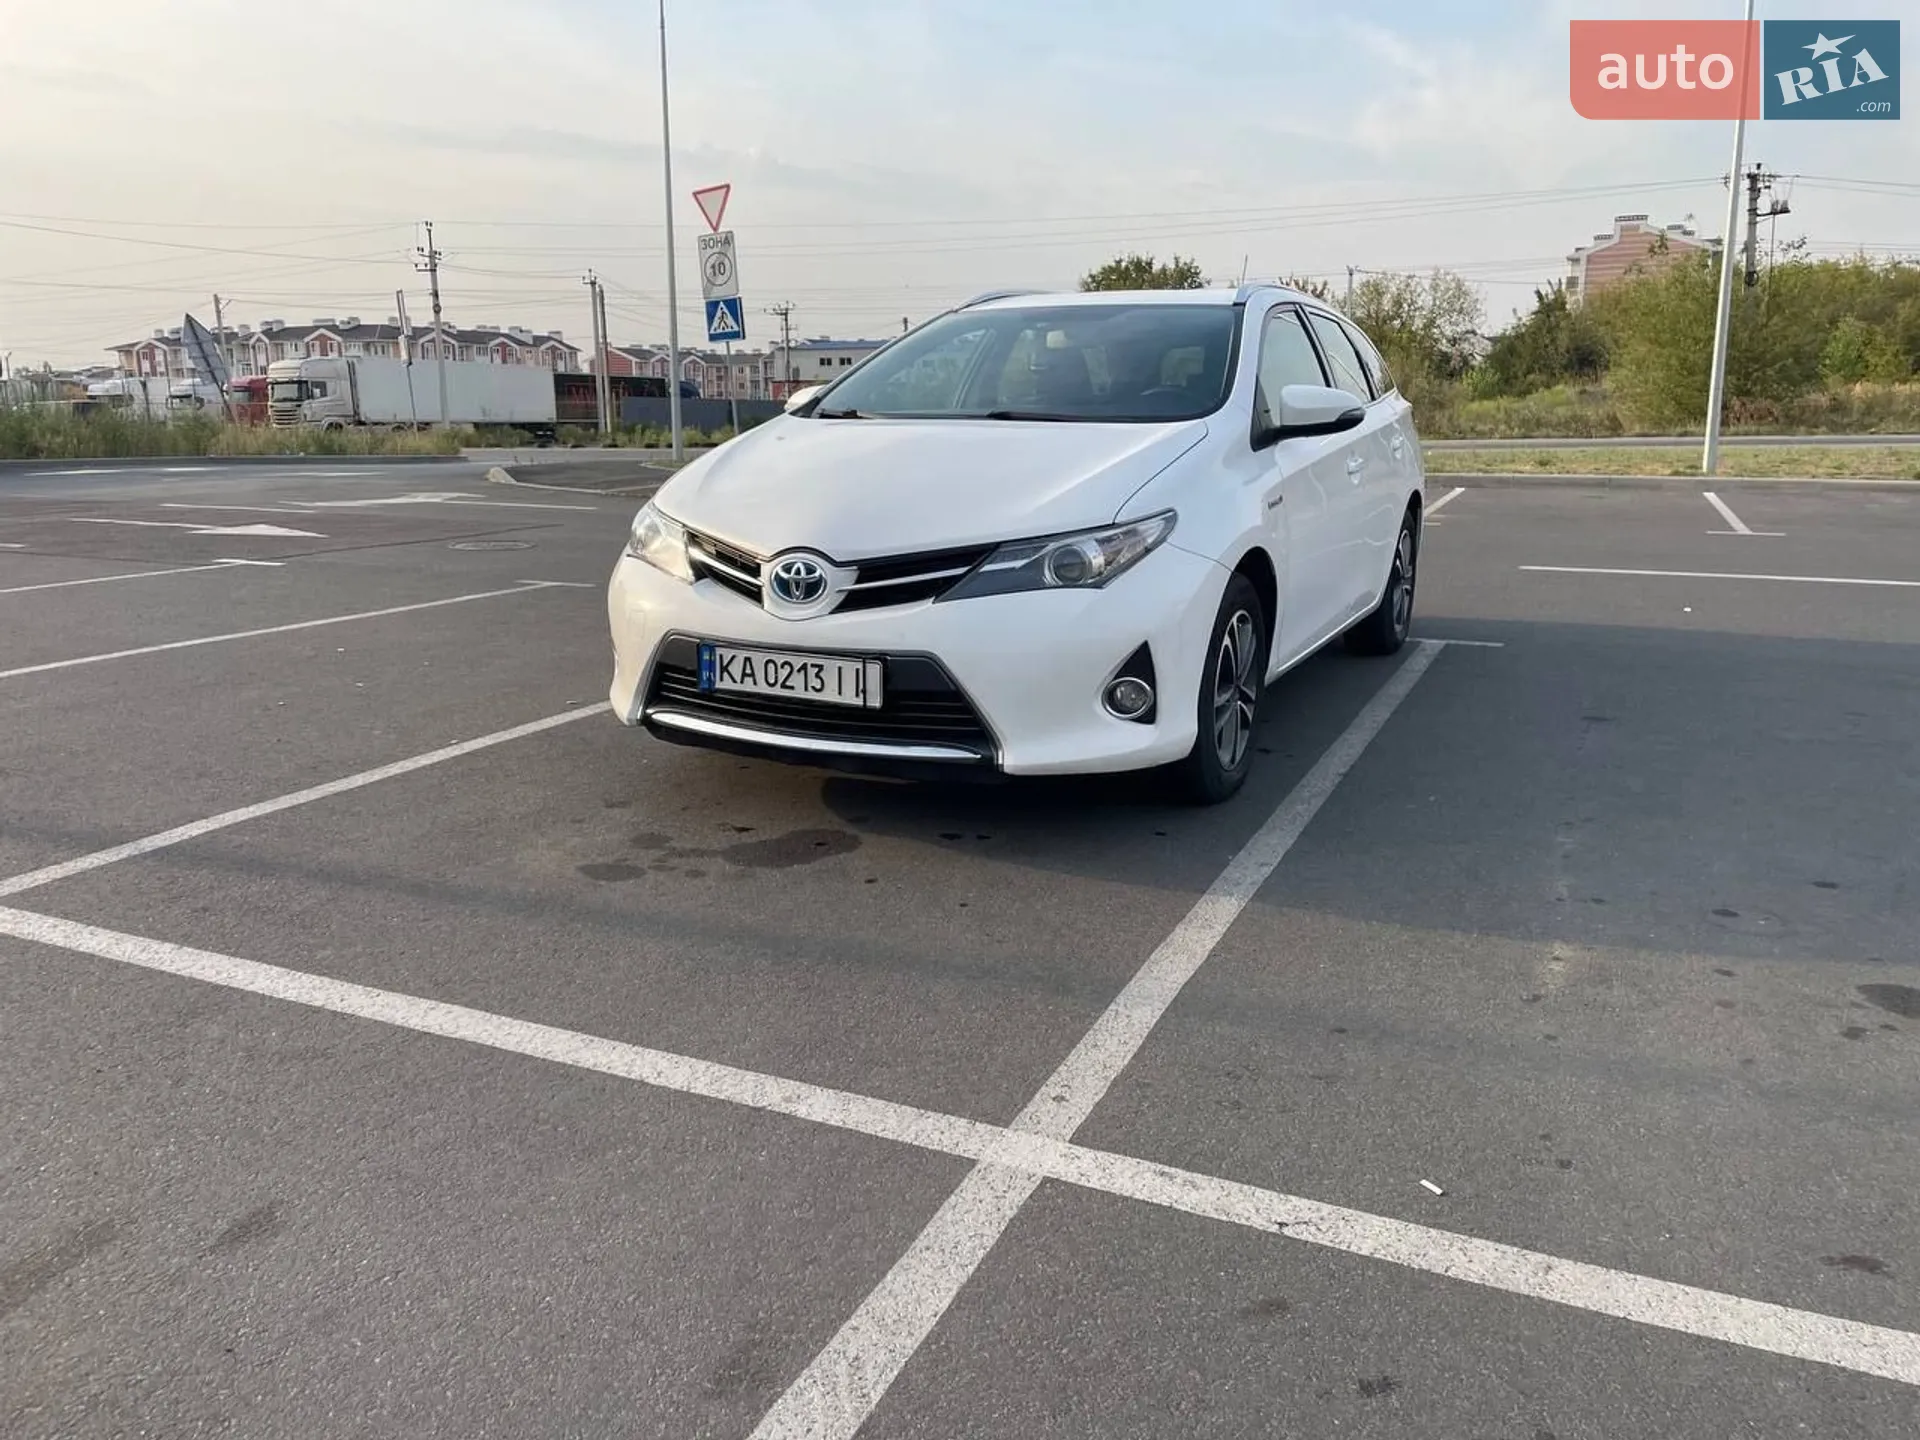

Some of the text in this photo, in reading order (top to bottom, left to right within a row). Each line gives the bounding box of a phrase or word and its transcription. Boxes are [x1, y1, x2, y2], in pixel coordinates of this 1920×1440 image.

[700, 235, 732, 251] ЗОНА
[709, 261, 726, 277] 10
[719, 653, 758, 686] KA
[763, 658, 825, 693] 0213
